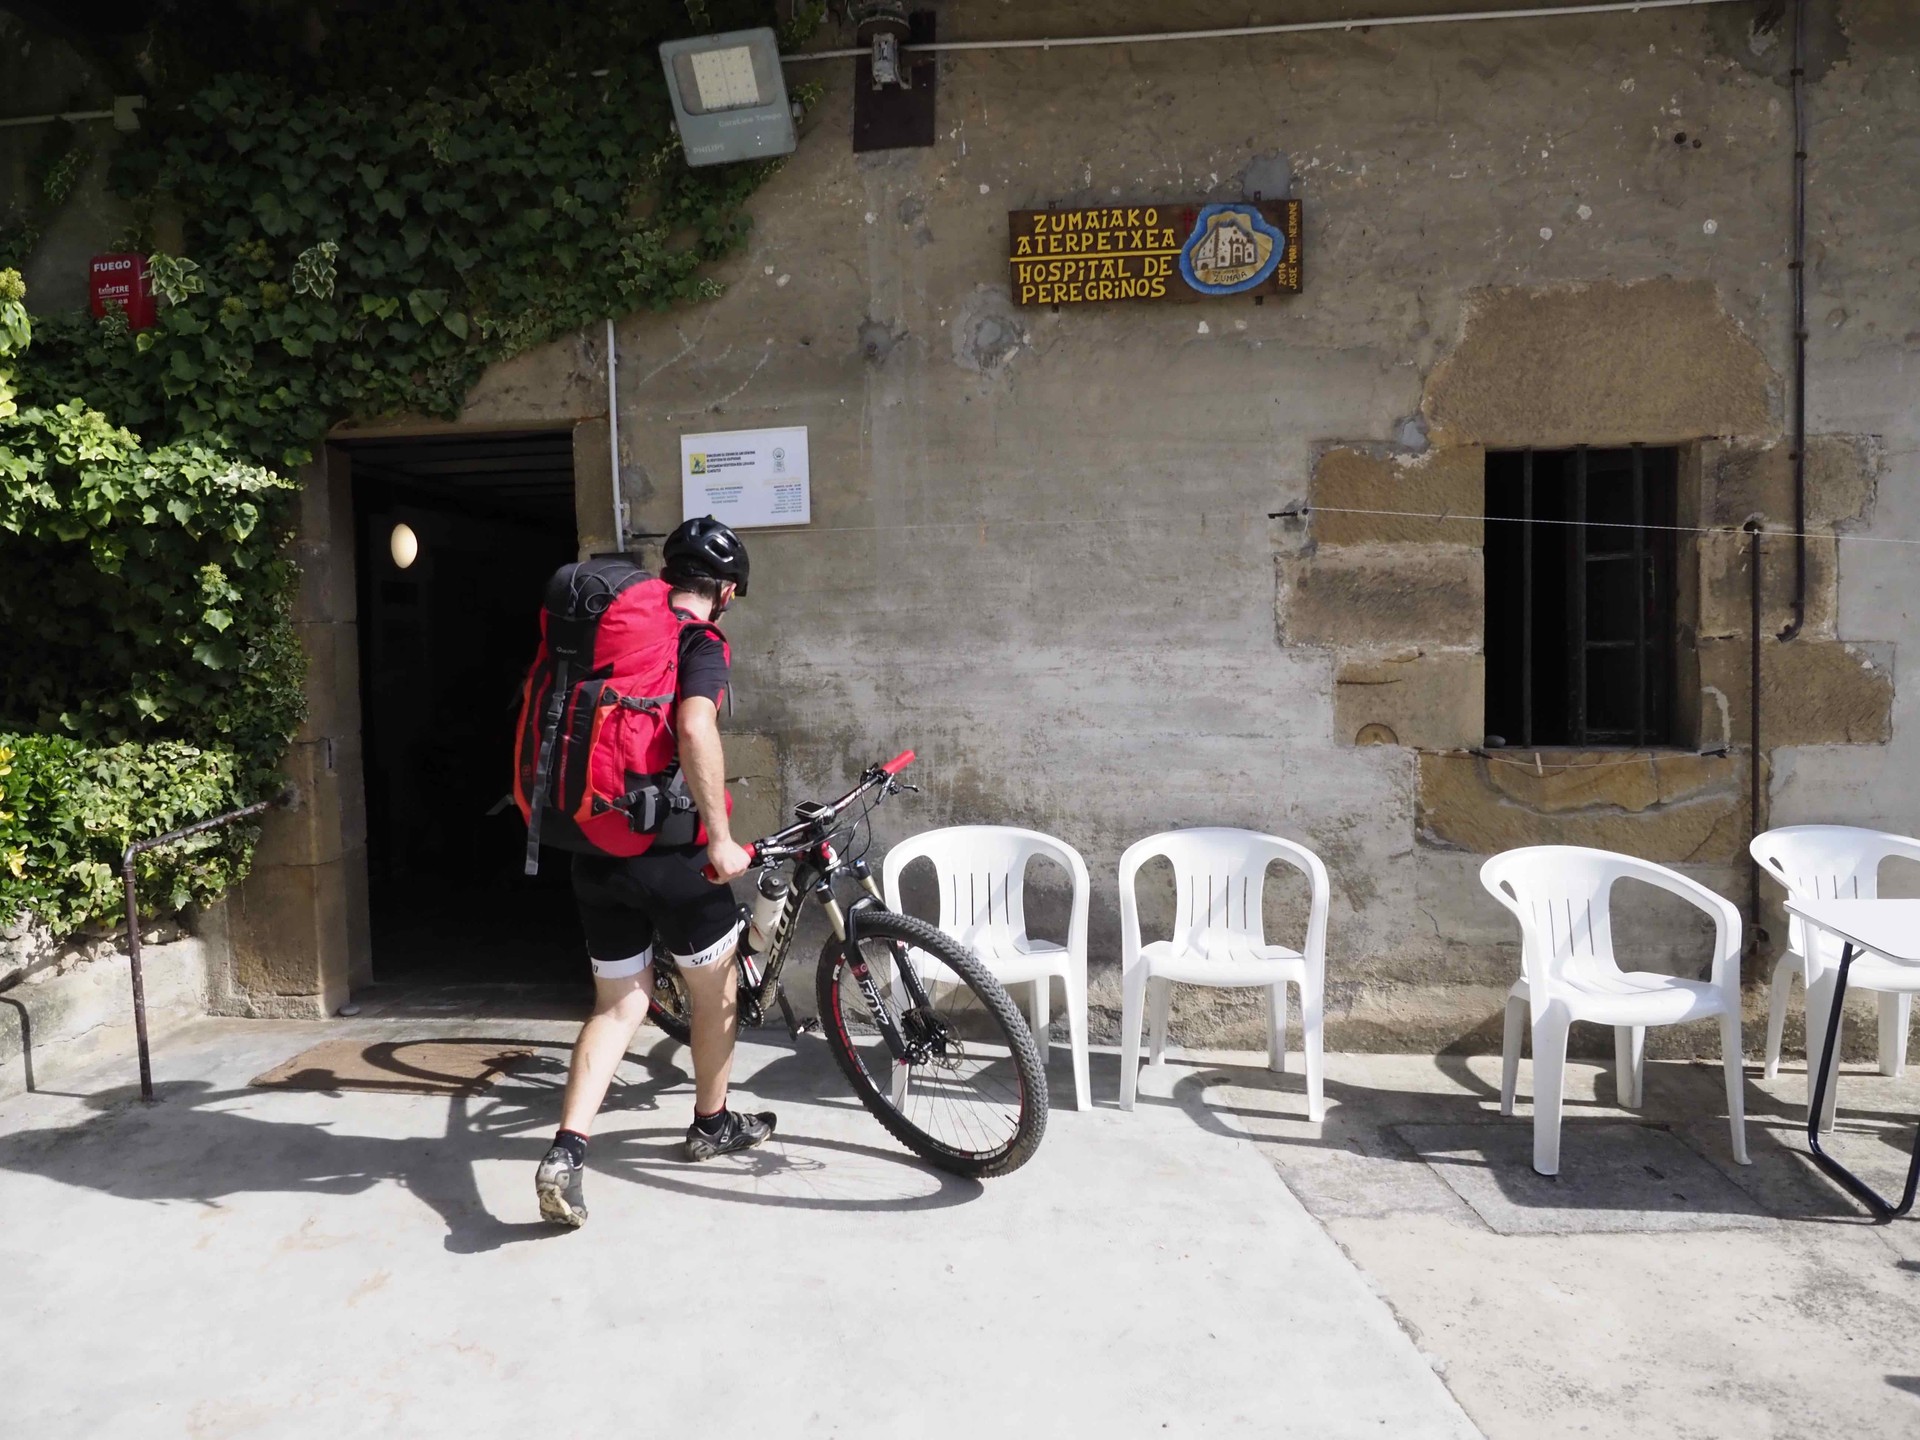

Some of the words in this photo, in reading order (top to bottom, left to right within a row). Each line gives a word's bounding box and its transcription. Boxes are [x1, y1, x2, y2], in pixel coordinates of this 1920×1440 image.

[693, 144, 725, 154] PHILIPS
[1017, 228, 1176, 256] ATERPETXEA
[94, 260, 131, 272] FUEGO
[1144, 256, 1173, 277] DE
[1278, 262, 1287, 286] 2016
[1213, 271, 1248, 283] ZUMAIA
[1288, 267, 1298, 290] JOSE
